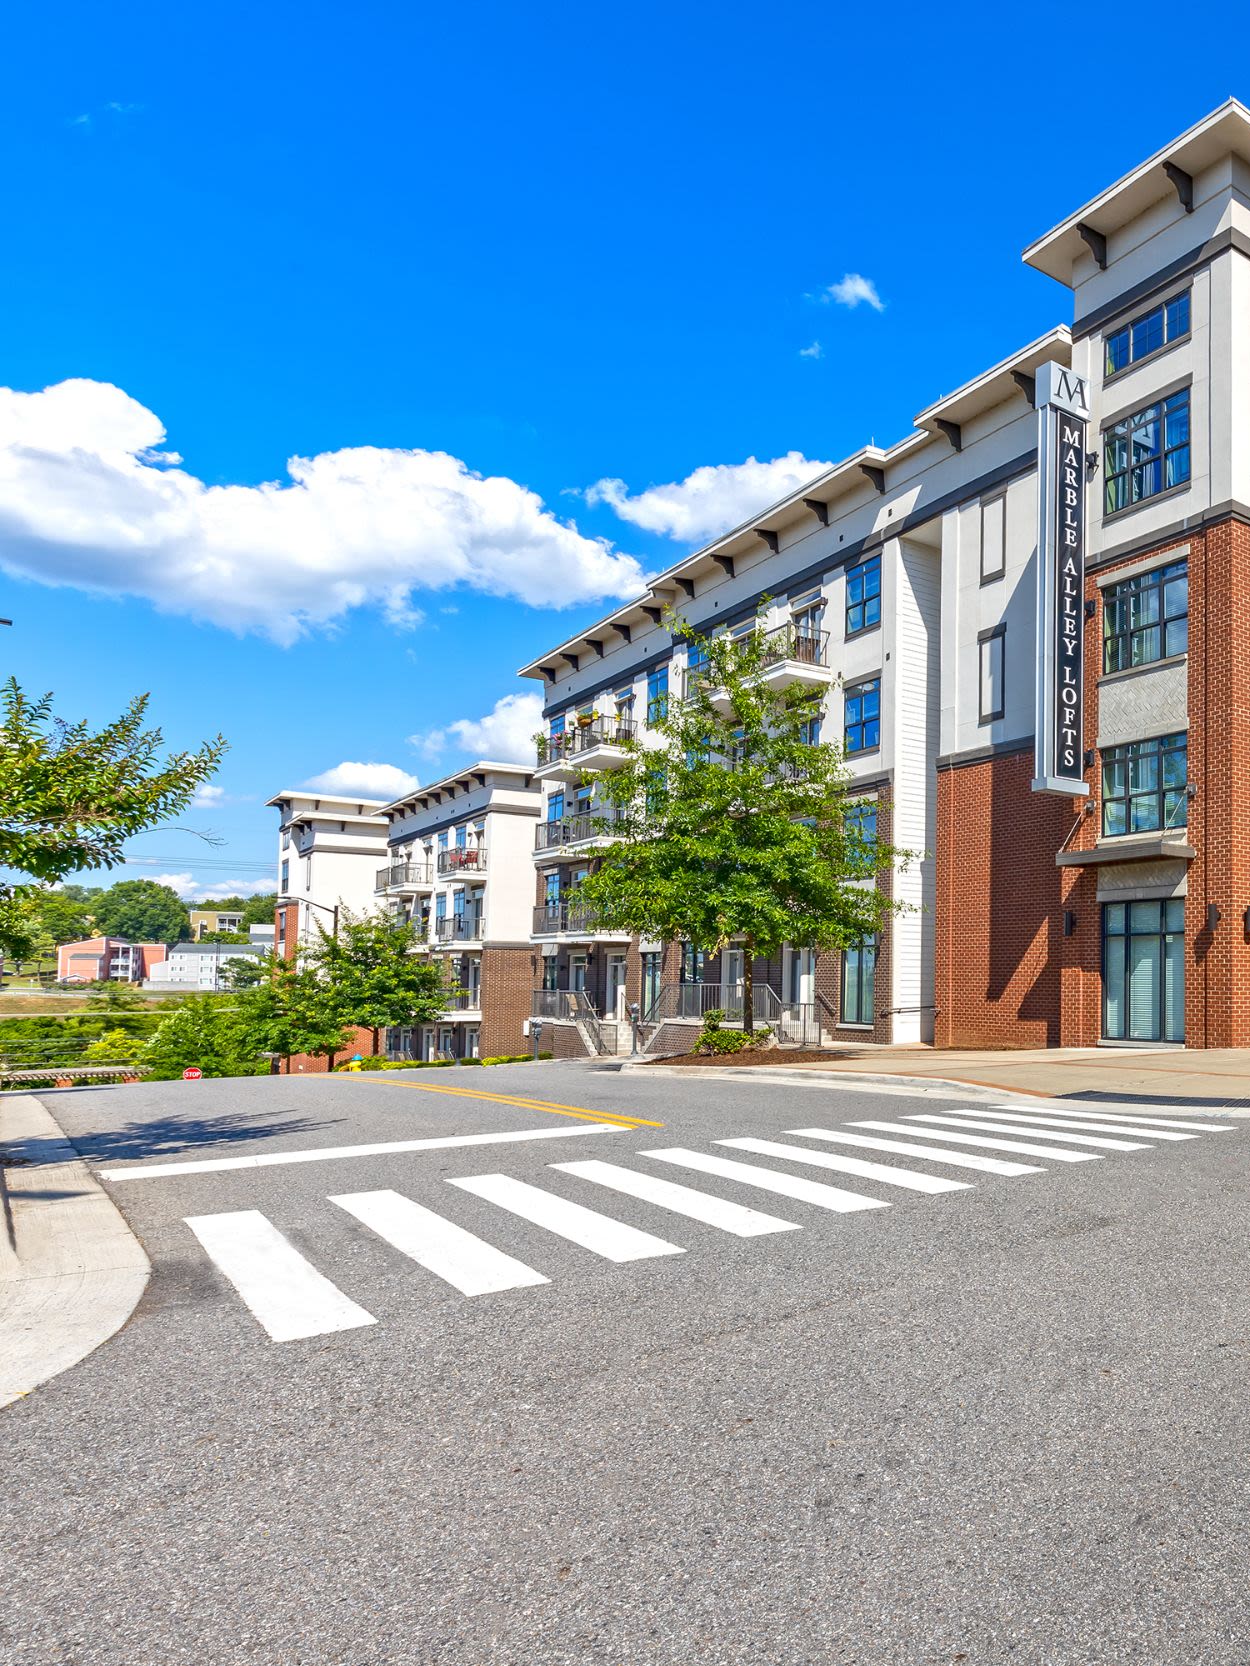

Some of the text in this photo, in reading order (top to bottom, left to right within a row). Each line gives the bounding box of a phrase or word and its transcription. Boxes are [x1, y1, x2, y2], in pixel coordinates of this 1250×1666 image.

[1062, 425, 1080, 767] MARBLE ALLEY LOFTS
